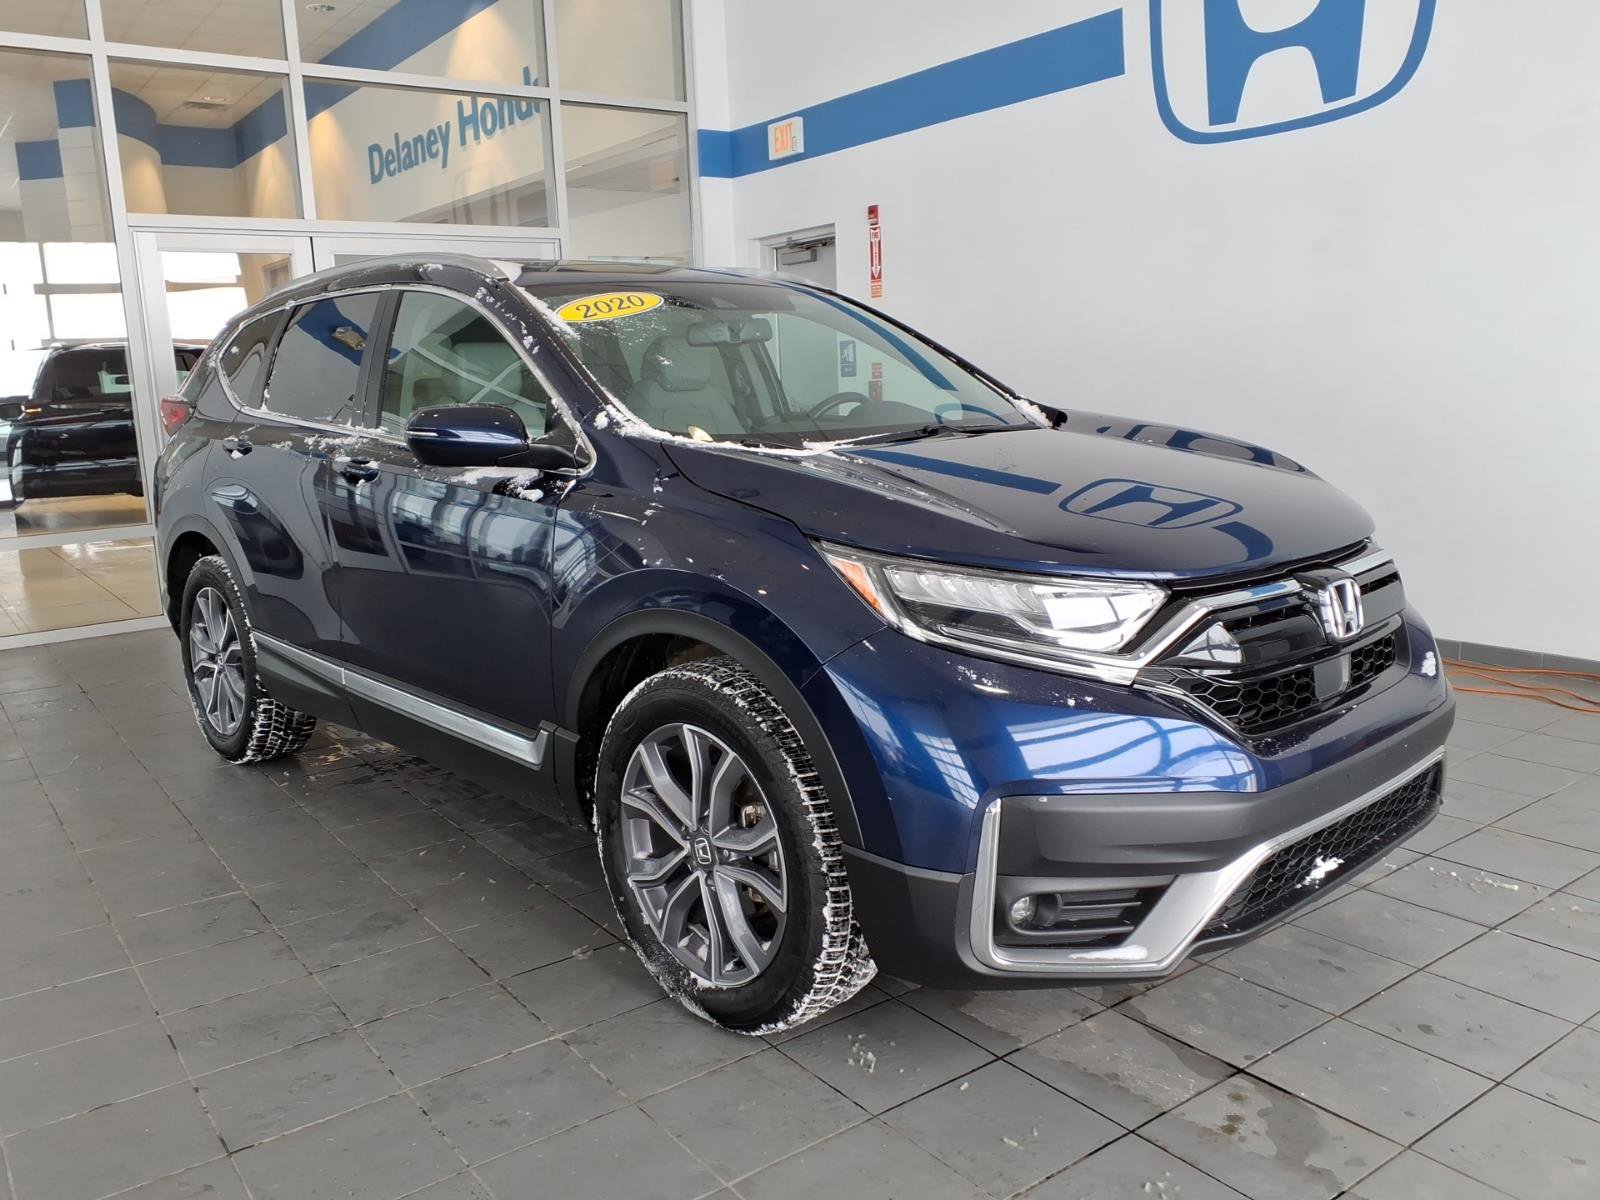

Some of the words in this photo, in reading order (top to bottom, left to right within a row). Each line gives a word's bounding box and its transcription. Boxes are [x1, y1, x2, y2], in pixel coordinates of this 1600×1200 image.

[367, 120, 451, 185] Delaney
[773, 121, 794, 154] EXIT
[575, 294, 645, 319] 2020
